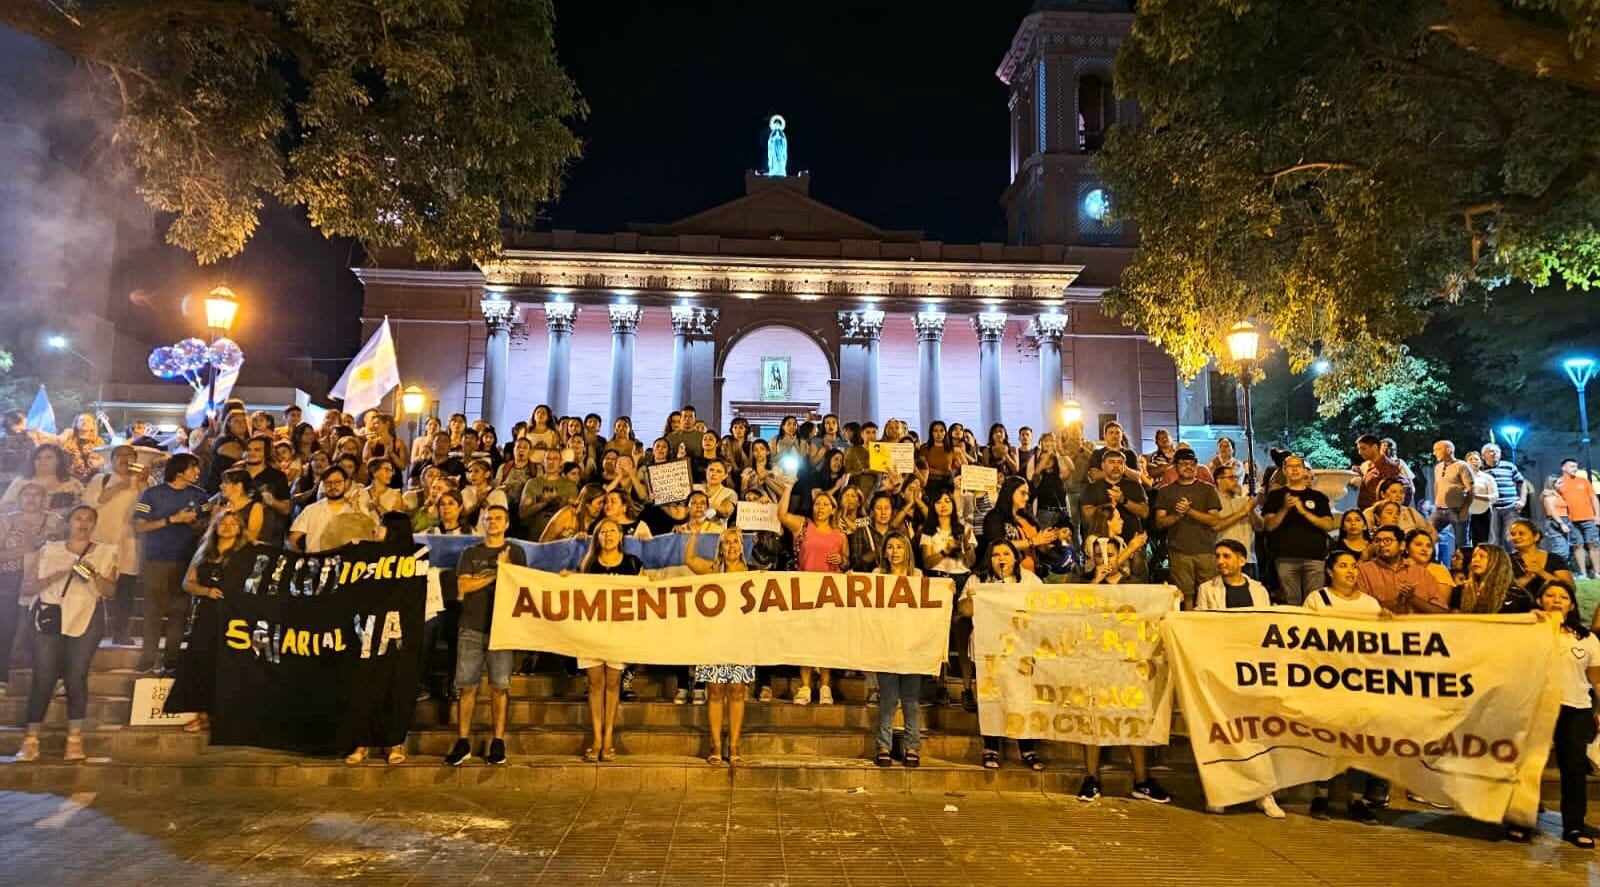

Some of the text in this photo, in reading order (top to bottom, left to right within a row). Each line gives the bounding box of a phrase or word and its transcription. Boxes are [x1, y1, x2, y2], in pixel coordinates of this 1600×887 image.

[511, 575, 943, 622] AUMENTO SALARIAL
[225, 611, 402, 664] SALARIAL YA
[1261, 623, 1450, 658] ASAMBLEA
[1236, 662, 1474, 698] DE DOCENTES
[1004, 712, 1147, 738] DOCENT
[1208, 716, 1519, 763] AUTOCONVOCADO
